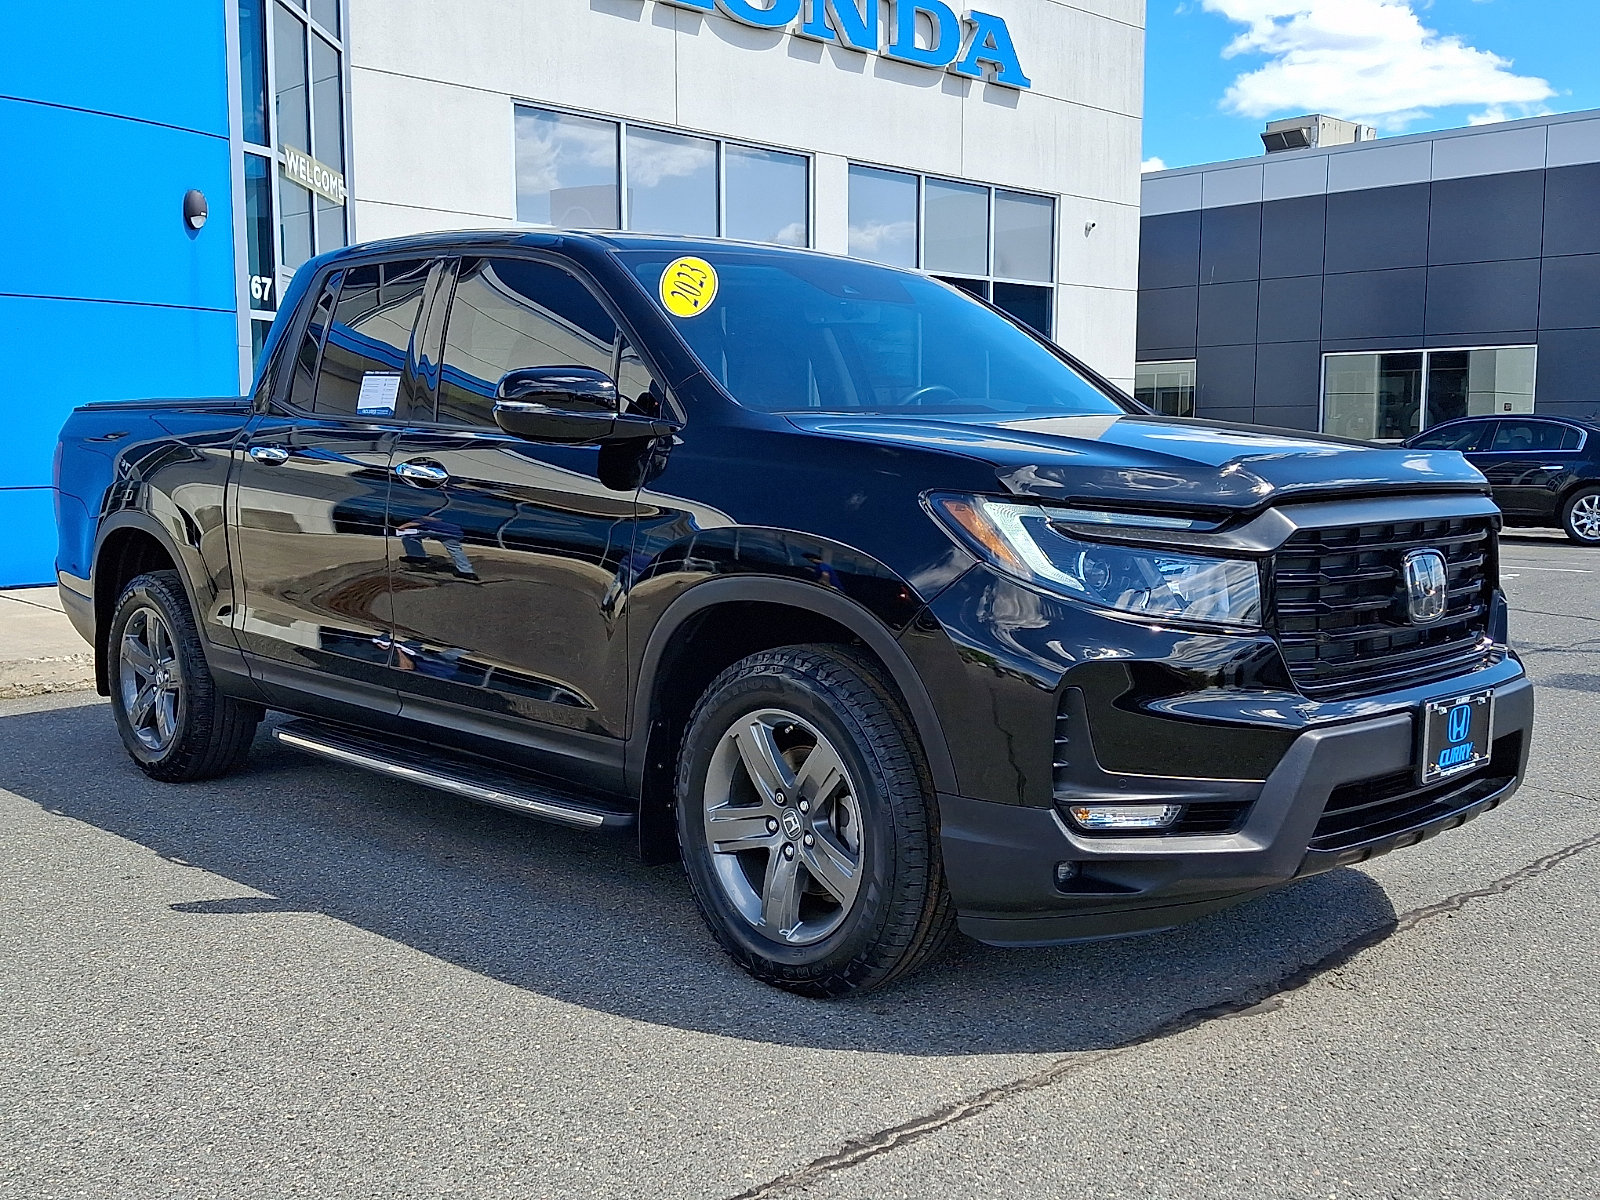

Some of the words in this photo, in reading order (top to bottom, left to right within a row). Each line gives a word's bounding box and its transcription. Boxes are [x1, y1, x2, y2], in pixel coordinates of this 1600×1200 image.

[676, 0, 1031, 89] NDA
[285, 148, 344, 201] WELCOME
[248, 275, 272, 301] 67
[671, 263, 707, 308] 2023
[1439, 742, 1473, 767] CURRY
